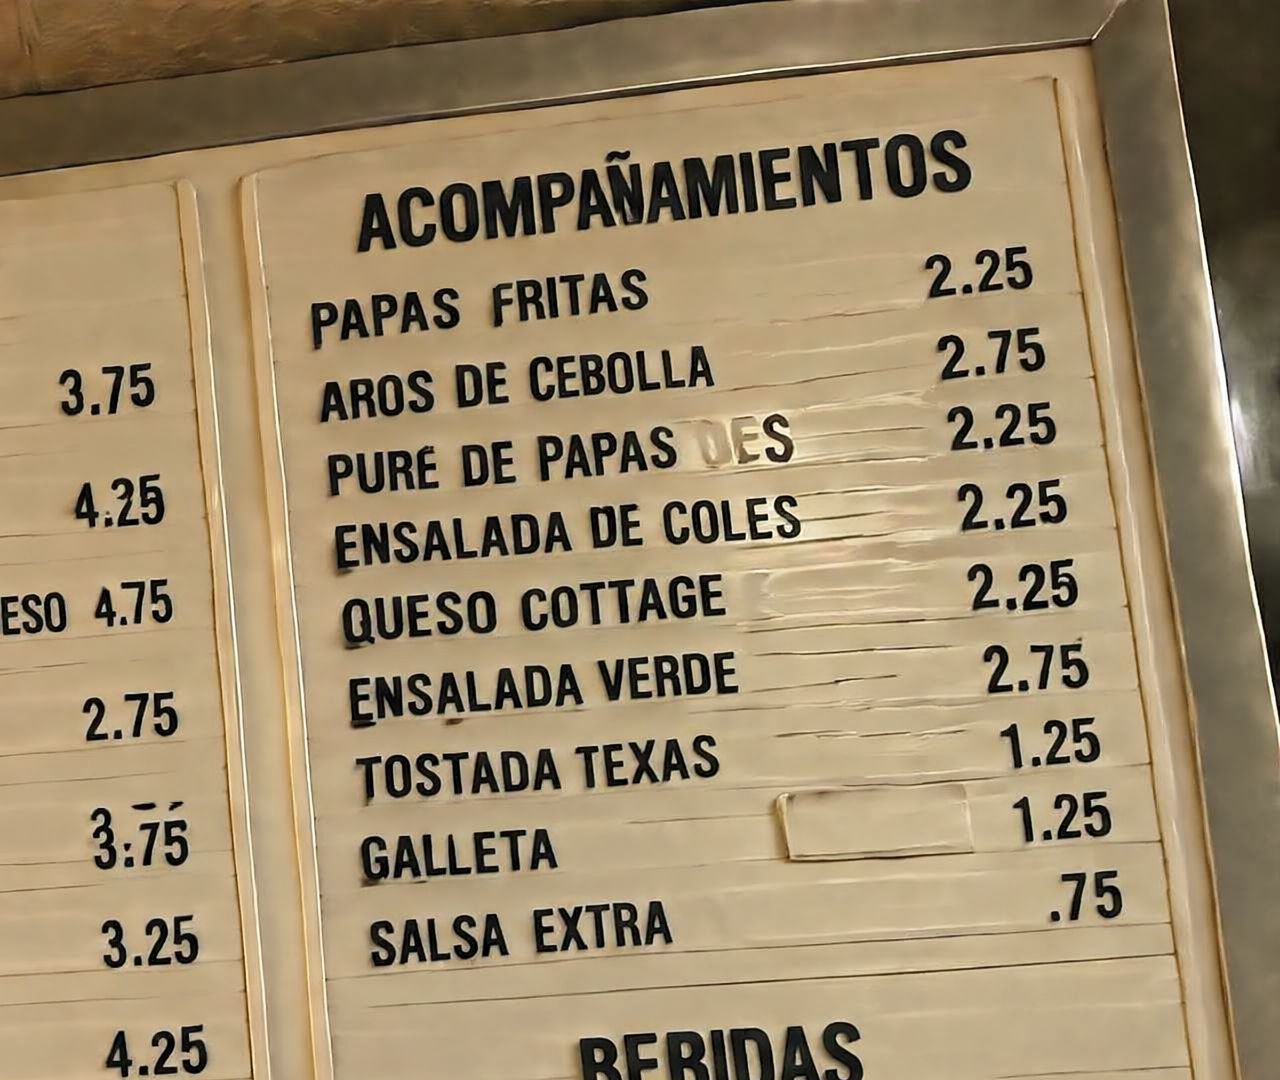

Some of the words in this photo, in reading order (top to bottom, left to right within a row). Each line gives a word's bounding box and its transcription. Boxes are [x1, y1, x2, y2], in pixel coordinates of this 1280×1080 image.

[356, 129, 972, 253] ACOMPAÑAMIENTOS
[310, 287, 461, 351] PAPAS
[492, 268, 649, 328] FRITAS
[924, 246, 1034, 299] 2.25
[58, 362, 155, 417] 3.75
[319, 370, 435, 423] AROS
[455, 361, 510, 409] DE
[528, 345, 715, 402] CEBOLLA
[936, 327, 1046, 381] 2.75
[461, 440, 517, 488] DE
[537, 426, 678, 482] PAPAS
[946, 401, 1057, 451] 2.25
[73, 473, 165, 529] 4.25
[334, 511, 573, 575] ENSALADA
[589, 503, 644, 549] DE
[662, 495, 801, 546] COLES
[957, 478, 1068, 532] 2.25
[94, 578, 173, 628] 4.75
[341, 590, 497, 651] QUESO
[520, 573, 727, 632] COTTAGE
[967, 558, 1079, 612] 2.25
[82, 691, 179, 742] 2.75
[349, 663, 584, 730] ENSALADA
[596, 651, 739, 702] VERDE
[983, 643, 1090, 695] 2.75
[355, 748, 562, 807] TOSTADA
[574, 734, 720, 789] TEXAS
[999, 717, 1101, 769] 1.25
[360, 828, 559, 887] GALLETA
[1012, 791, 1112, 843] 1.25
[101, 914, 199, 969] 3.25
[369, 913, 510, 968] SALSA
[532, 900, 674, 954] EXTRA
[1050, 870, 1123, 923] .75
[104, 1024, 208, 1078] 4.25
